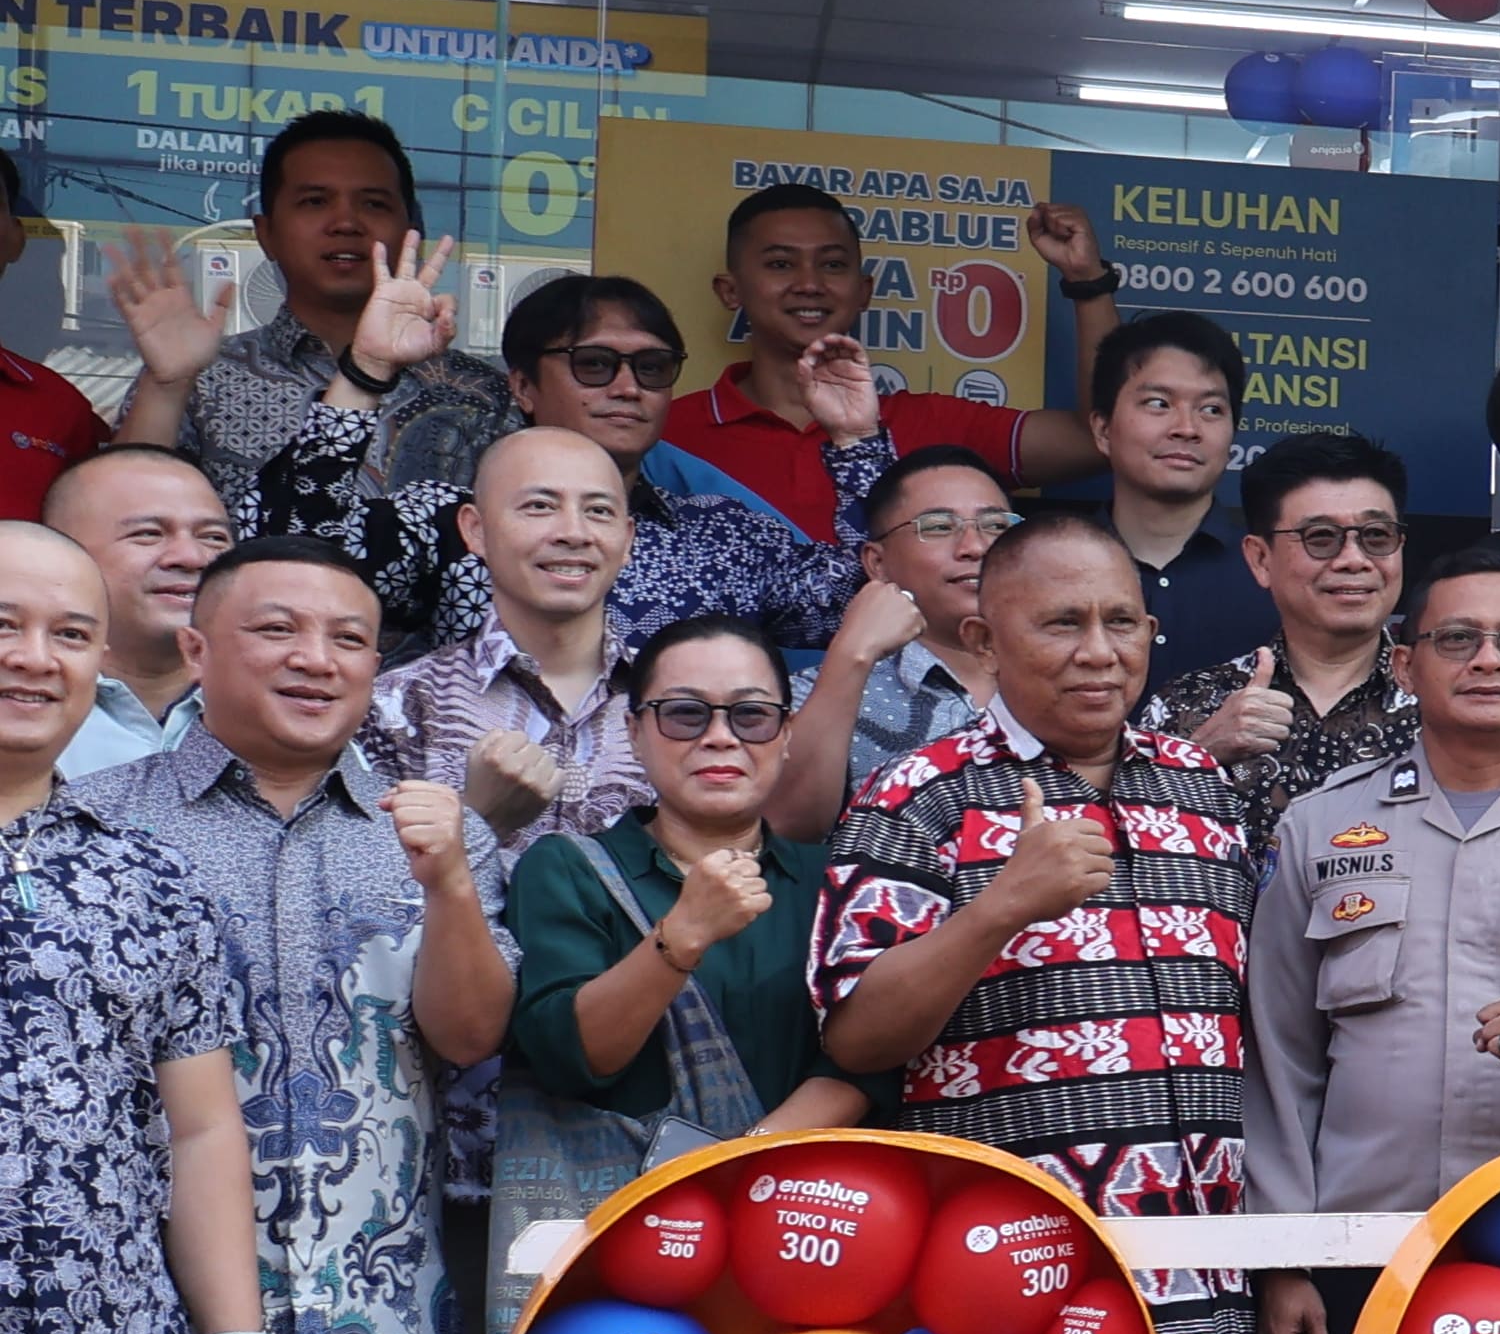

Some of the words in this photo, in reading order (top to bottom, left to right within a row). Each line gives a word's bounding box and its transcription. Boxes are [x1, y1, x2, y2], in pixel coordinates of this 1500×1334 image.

[364, 25, 498, 60] UNTUK
[127, 70, 158, 116] 1
[137, 128, 244, 155] DALAM
[158, 153, 198, 174] jika
[734, 160, 855, 195] BAYAR
[859, 170, 931, 199] APA
[938, 174, 1034, 208] SAJA
[1112, 183, 1340, 236] KELUHAN
[1114, 235, 1199, 254] Responsif
[1203, 242, 1216, 255] &
[1220, 242, 1297, 260] Sepenuh
[1302, 247, 1337, 263] Hati
[929, 269, 967, 295] Rp
[1111, 263, 1195, 292] 0800
[1203, 268, 1223, 294] 2
[1231, 270, 1296, 298] 600
[1303, 275, 1369, 303] 600
[1315, 853, 1394, 881] WISNU.S
[778, 1177, 870, 1207] erablue
[776, 1208, 826, 1231] TOKO
[830, 1218, 857, 1238] KE
[779, 1233, 841, 1267] 300
